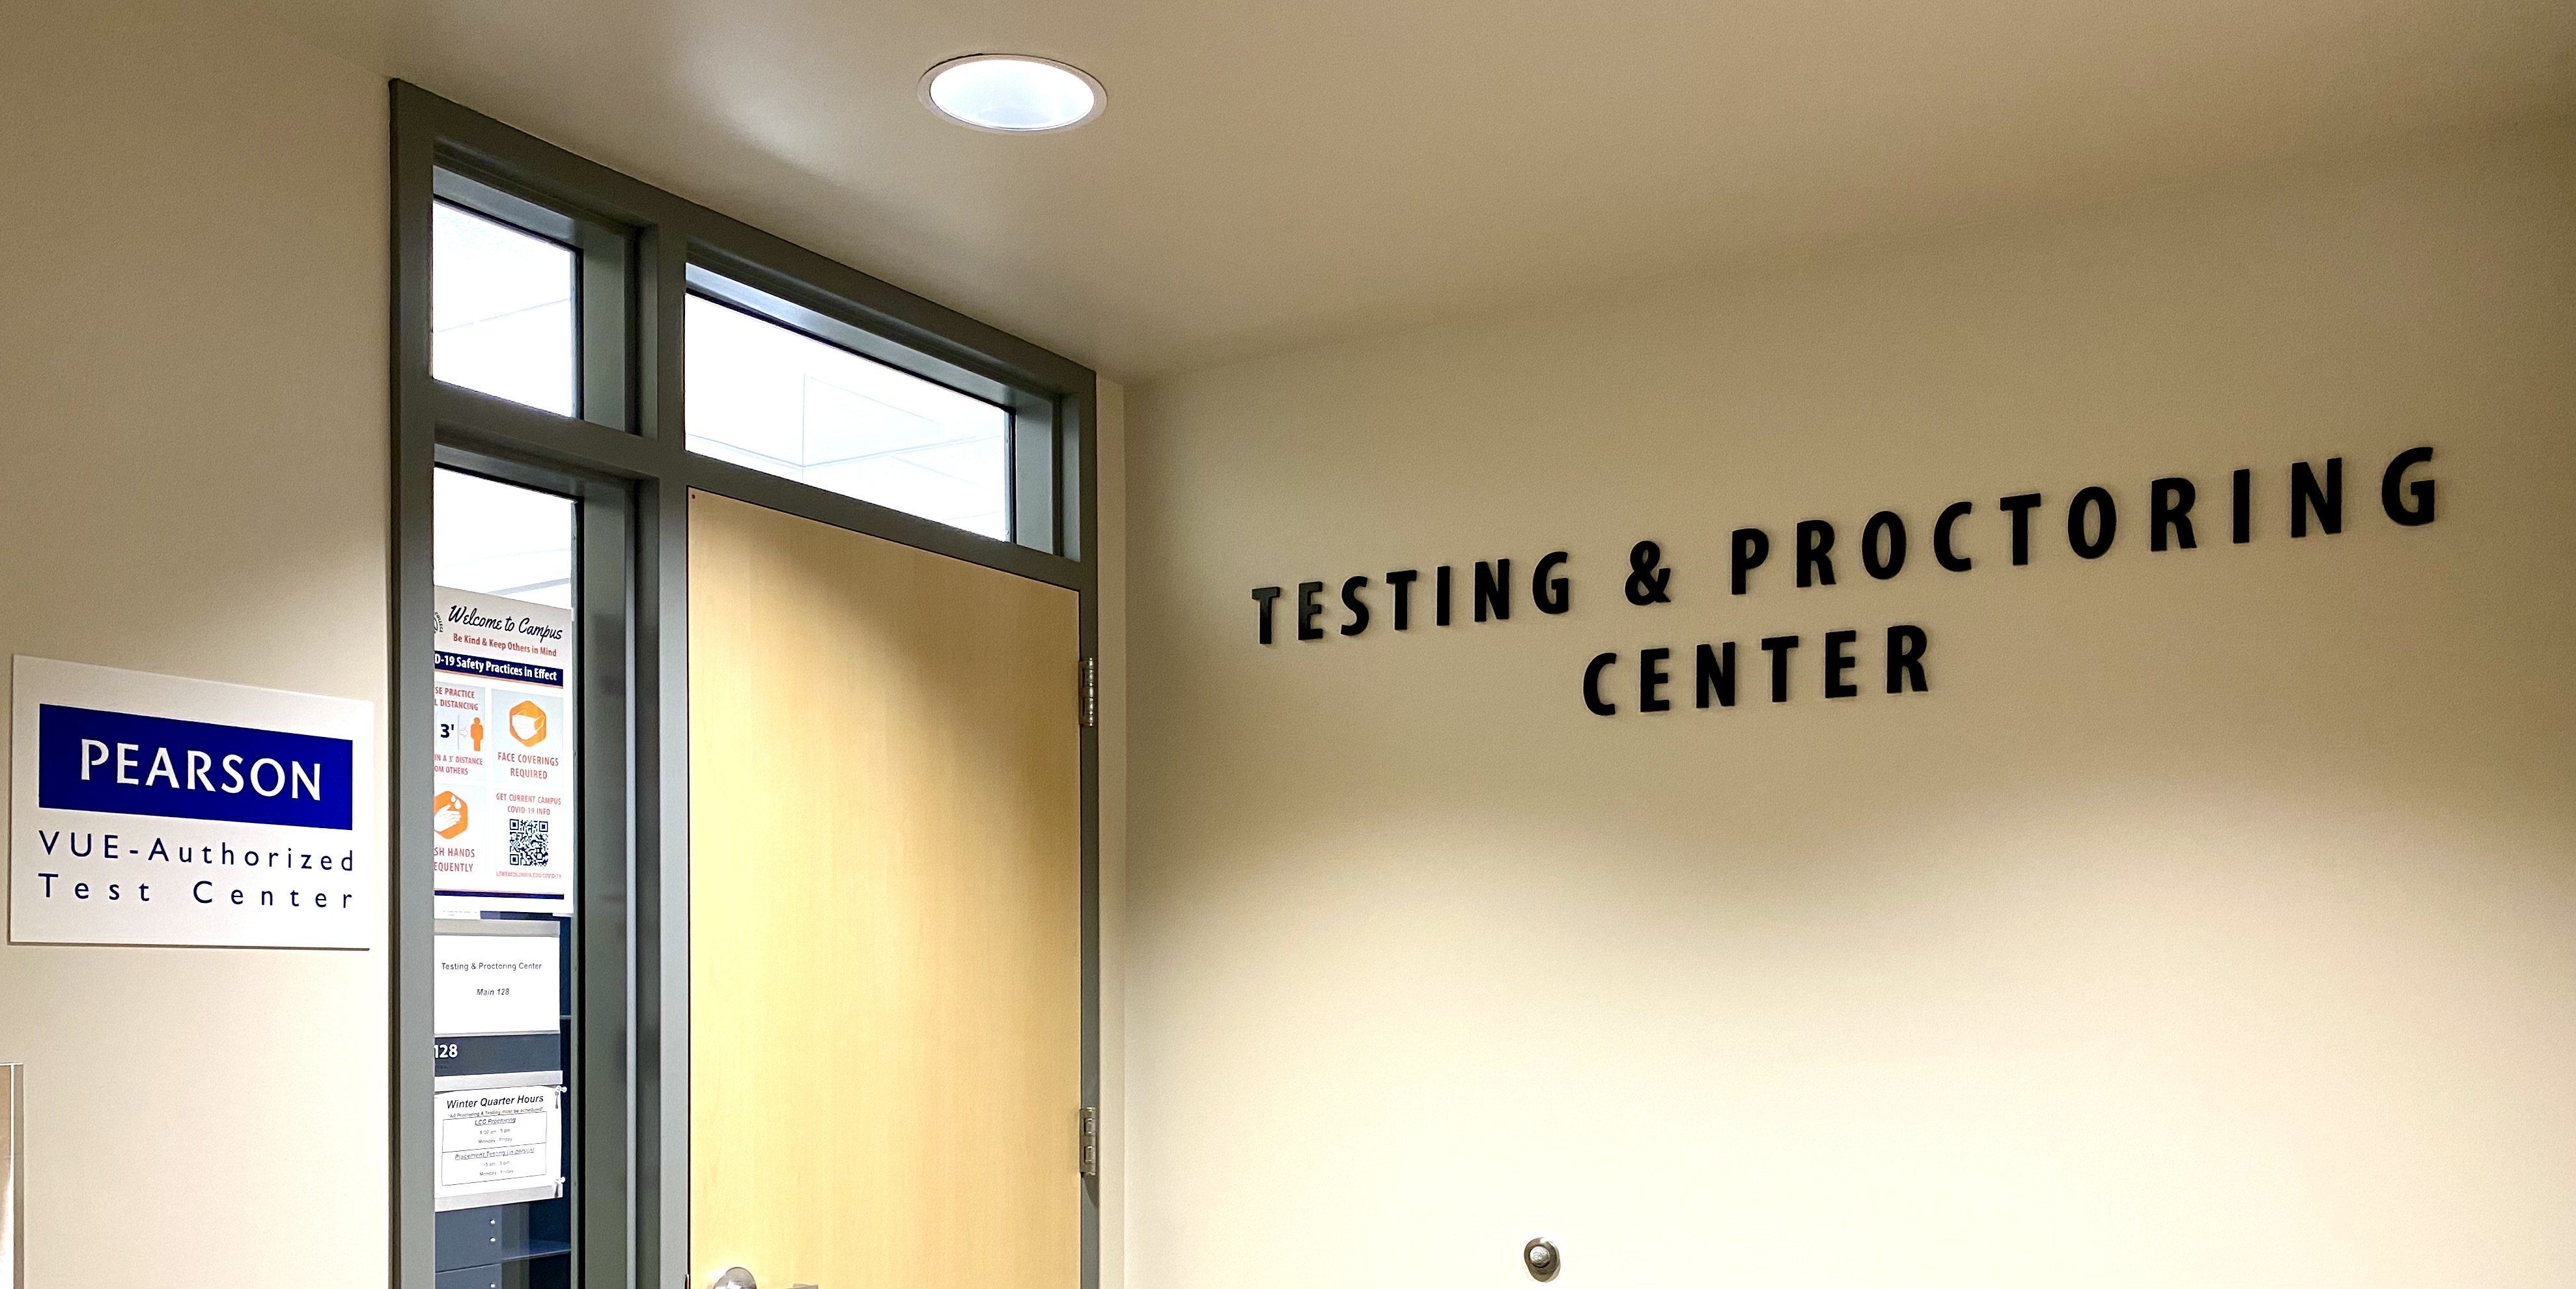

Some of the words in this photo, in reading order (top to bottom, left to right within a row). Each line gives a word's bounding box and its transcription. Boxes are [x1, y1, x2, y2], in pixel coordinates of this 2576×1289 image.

[1252, 551, 1570, 645] TESTING
[1625, 540, 1672, 607] &
[1730, 446, 2438, 597] PROCTORING
[448, 605, 502, 630] Welcome
[505, 617, 515, 631] to
[518, 618, 563, 643] Campus
[453, 633, 462, 642] Be
[464, 635, 480, 645] Kind
[482, 637, 487, 646] &
[489, 639, 506, 651] Keep
[508, 641, 530, 653] Others
[532, 646, 539, 654] in
[540, 647, 557, 657] Mind
[434, 654, 455, 666] D-19
[456, 656, 484, 672] Safety
[486, 661, 523, 676] Practices
[524, 667, 533, 678] in
[534, 669, 557, 681] Effect
[1582, 624, 1929, 717] CENTER
[445, 687, 475, 699] PRACTICE
[440, 699, 479, 711] DISTANCING
[440, 723, 455, 738] 3'
[456, 756, 483, 765] DISTANCE
[497, 752, 515, 762] FACE
[518, 754, 559, 766] COVERINGS
[81, 739, 320, 801] PEARSON
[446, 766, 468, 775] OTHERS
[511, 768, 547, 779] REQUIRED
[509, 794, 535, 803] CURRENT
[538, 797, 561, 805] CAMPUS
[38, 830, 353, 872] VUE-Authorized
[434, 847, 445, 856] SH
[447, 848, 475, 857] HANDS
[434, 862, 473, 872] EQUENTLY
[38, 874, 150, 902] Test
[193, 881, 352, 909] Center
[441, 963, 469, 971] Testing
[479, 963, 516, 971] Proctoring
[434, 1044, 458, 1059] 128
[447, 1100, 478, 1109] Winter
[480, 1097, 515, 1107] Quarter
[517, 1095, 544, 1104] Hours
